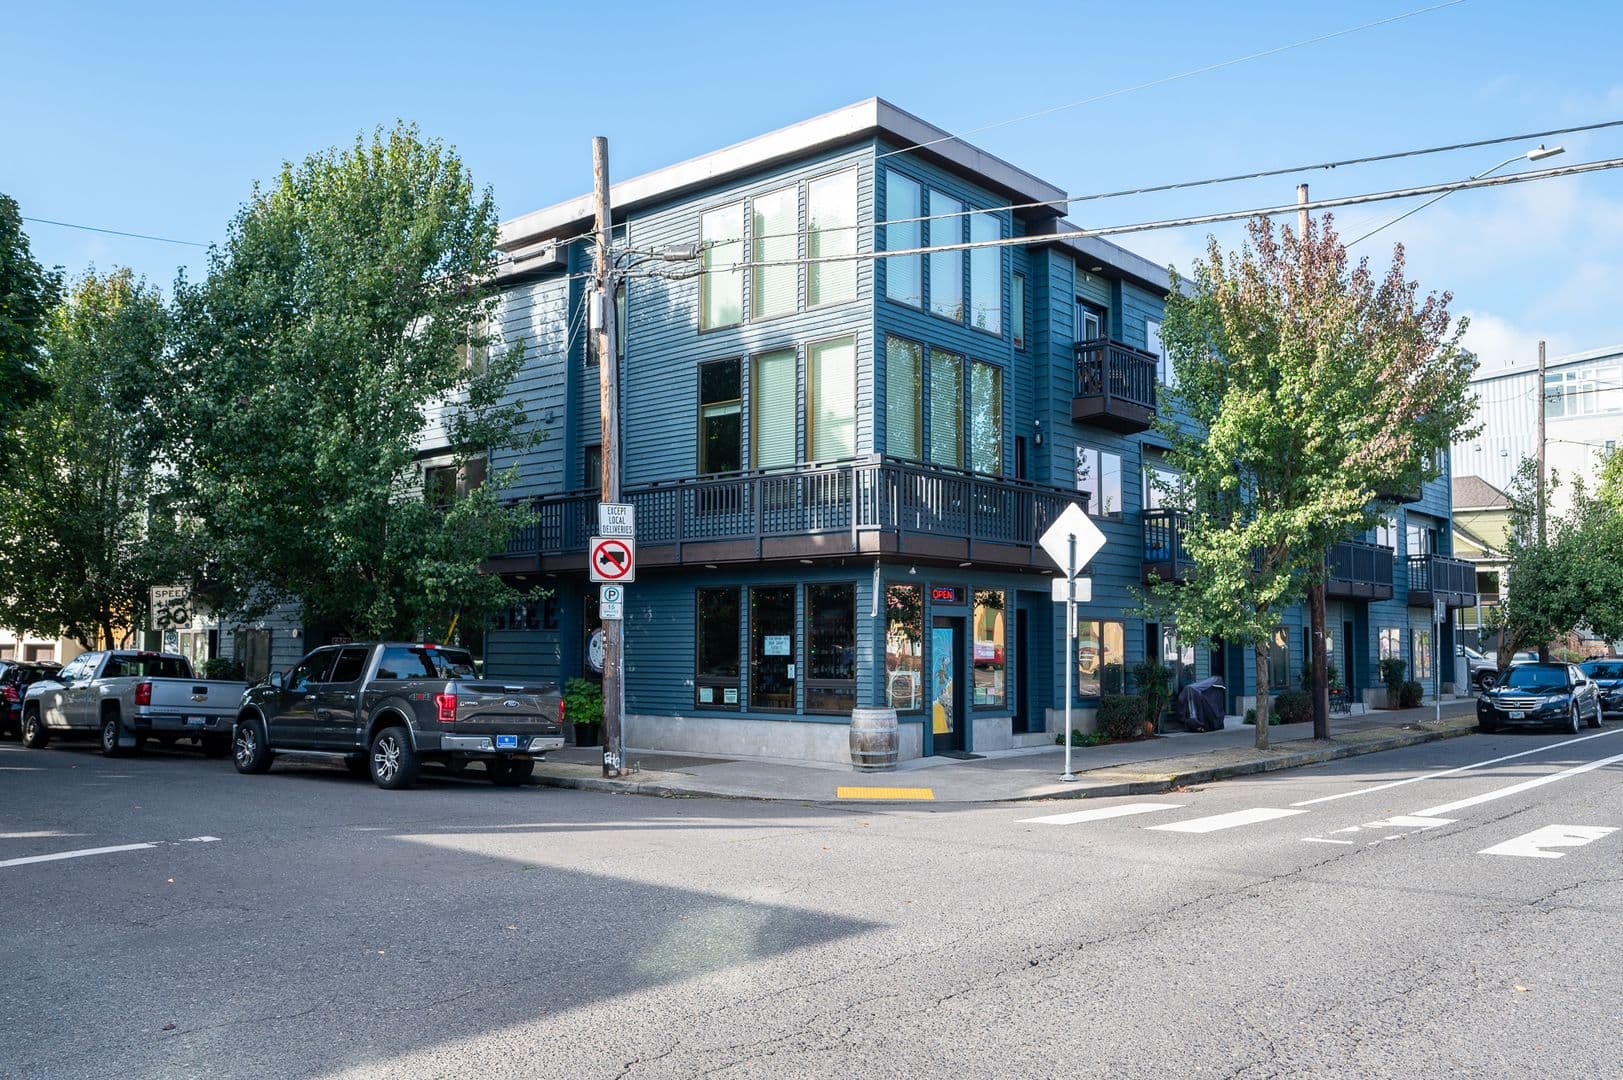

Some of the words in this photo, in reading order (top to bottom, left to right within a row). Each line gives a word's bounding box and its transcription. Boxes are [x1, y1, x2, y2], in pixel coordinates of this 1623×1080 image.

[607, 507, 627, 515] EXCEPT
[608, 516, 626, 525] LOCAL
[602, 525, 633, 534] DELIVERIES
[155, 590, 188, 598] SPEED
[608, 590, 616, 599] P
[932, 589, 953, 599] OPEN
